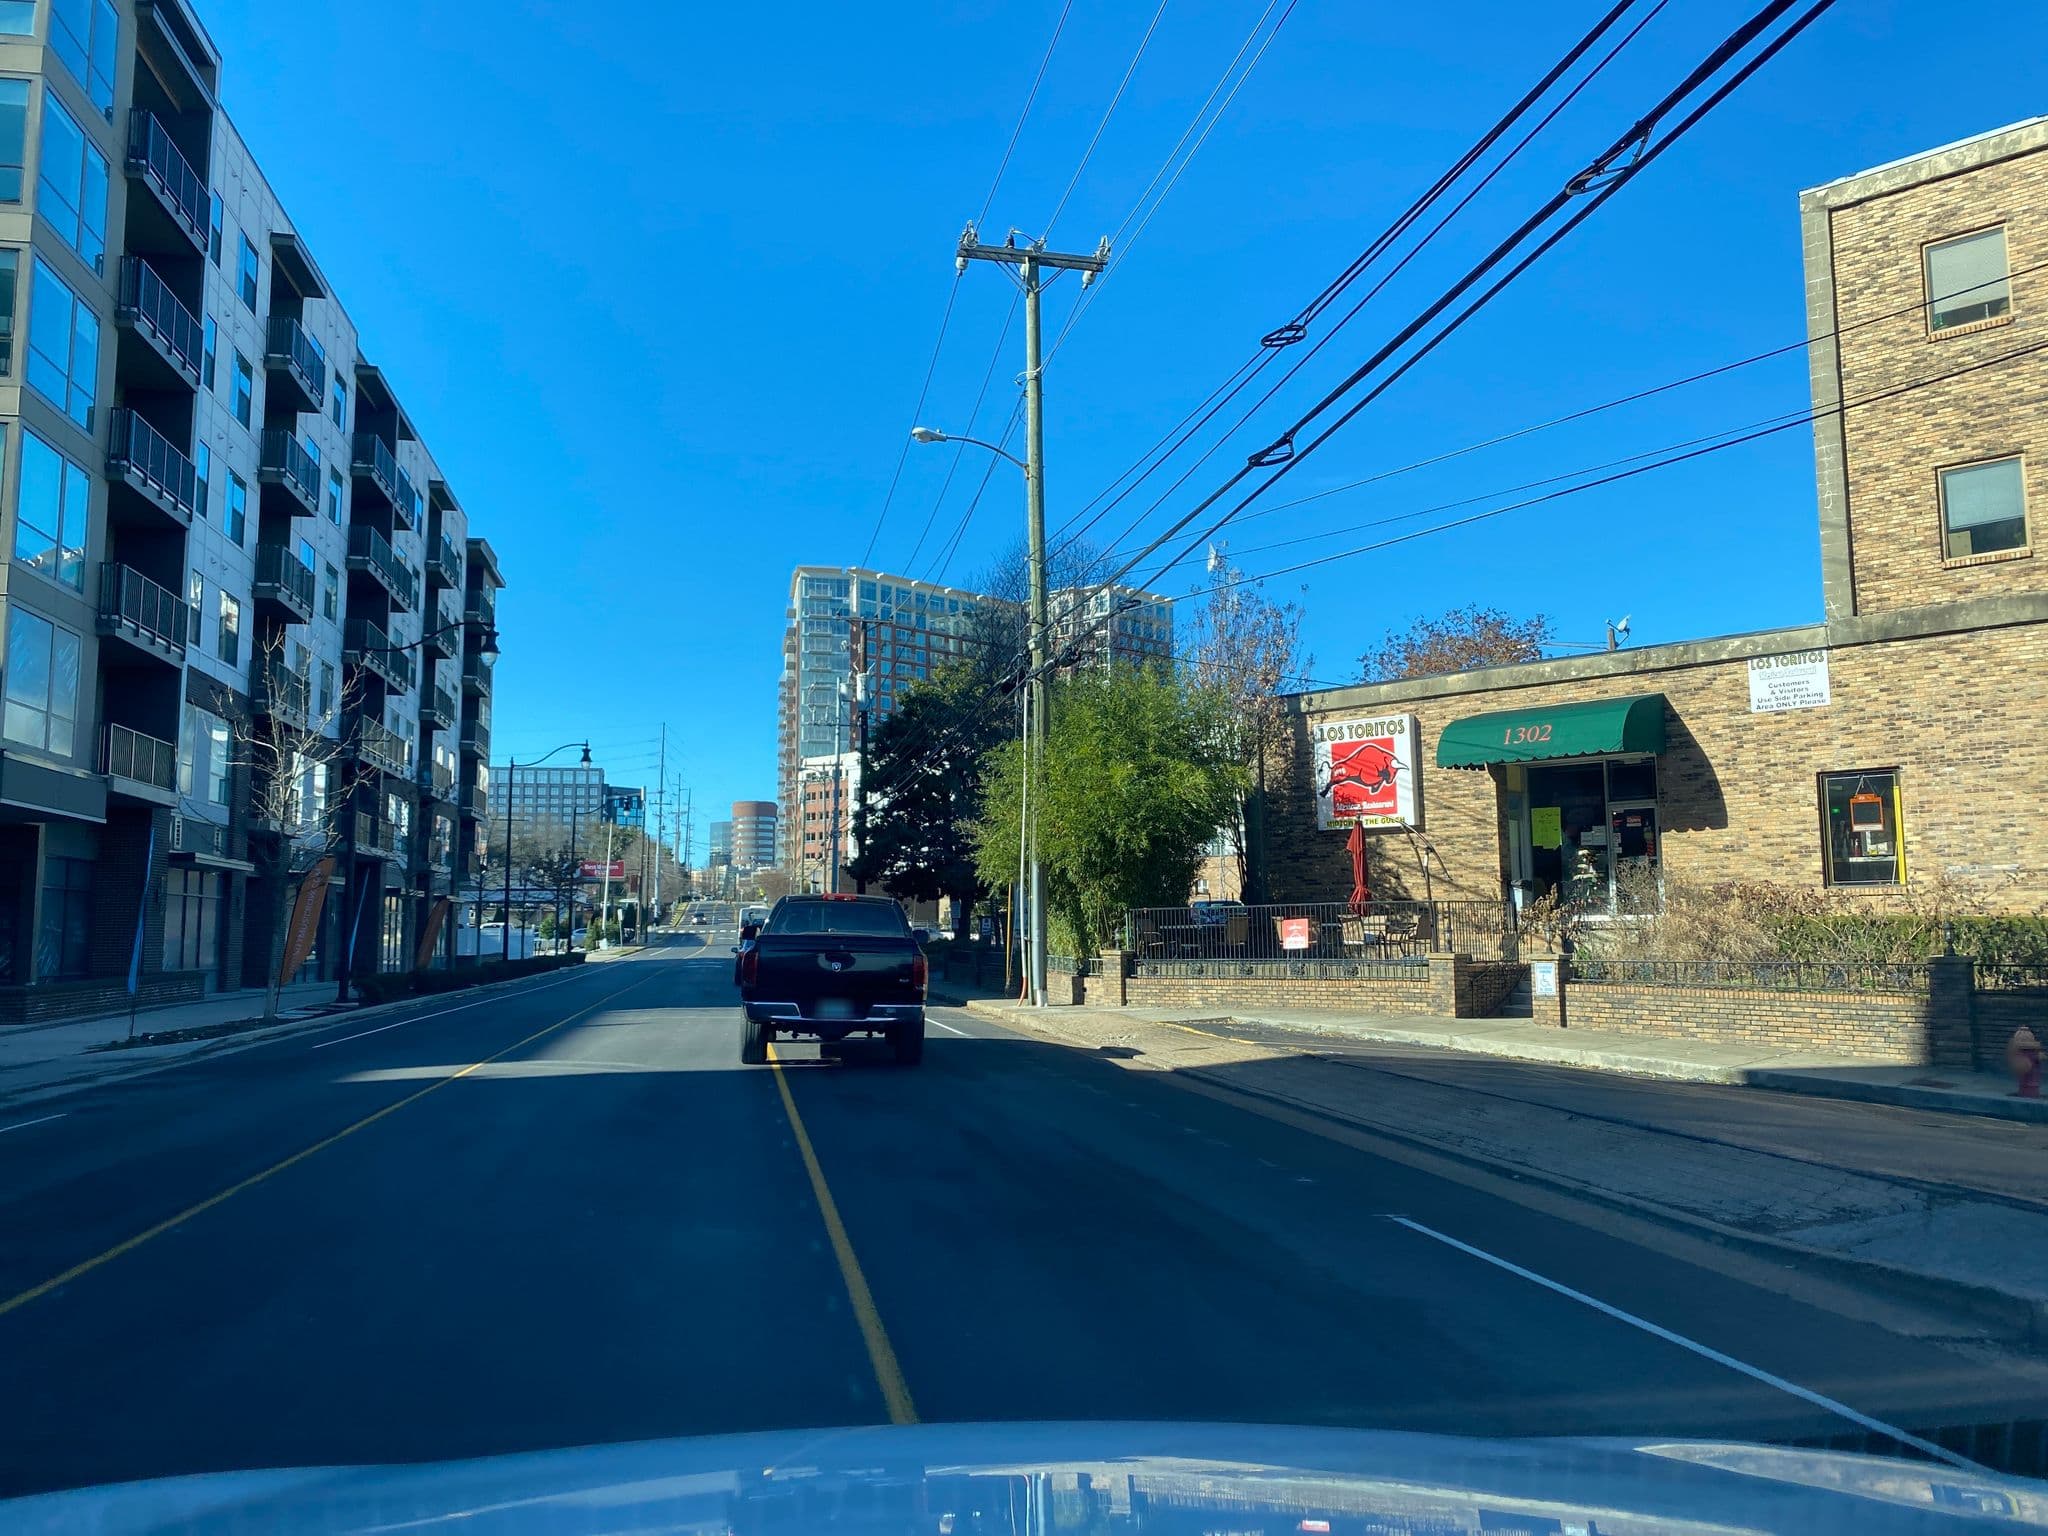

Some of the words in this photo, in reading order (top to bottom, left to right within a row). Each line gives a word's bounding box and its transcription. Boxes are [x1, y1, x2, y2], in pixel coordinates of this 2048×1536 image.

[1751, 657, 1771, 670] LOS
[1774, 651, 1824, 667] TORITOS
[1768, 680, 1810, 688] Customers
[1320, 726, 1344, 742] LOS
[1347, 719, 1405, 739] TORITOS
[1503, 724, 1552, 745] 1302
[1326, 819, 1356, 829] MIDTOW
[1365, 818, 1378, 826] THE
